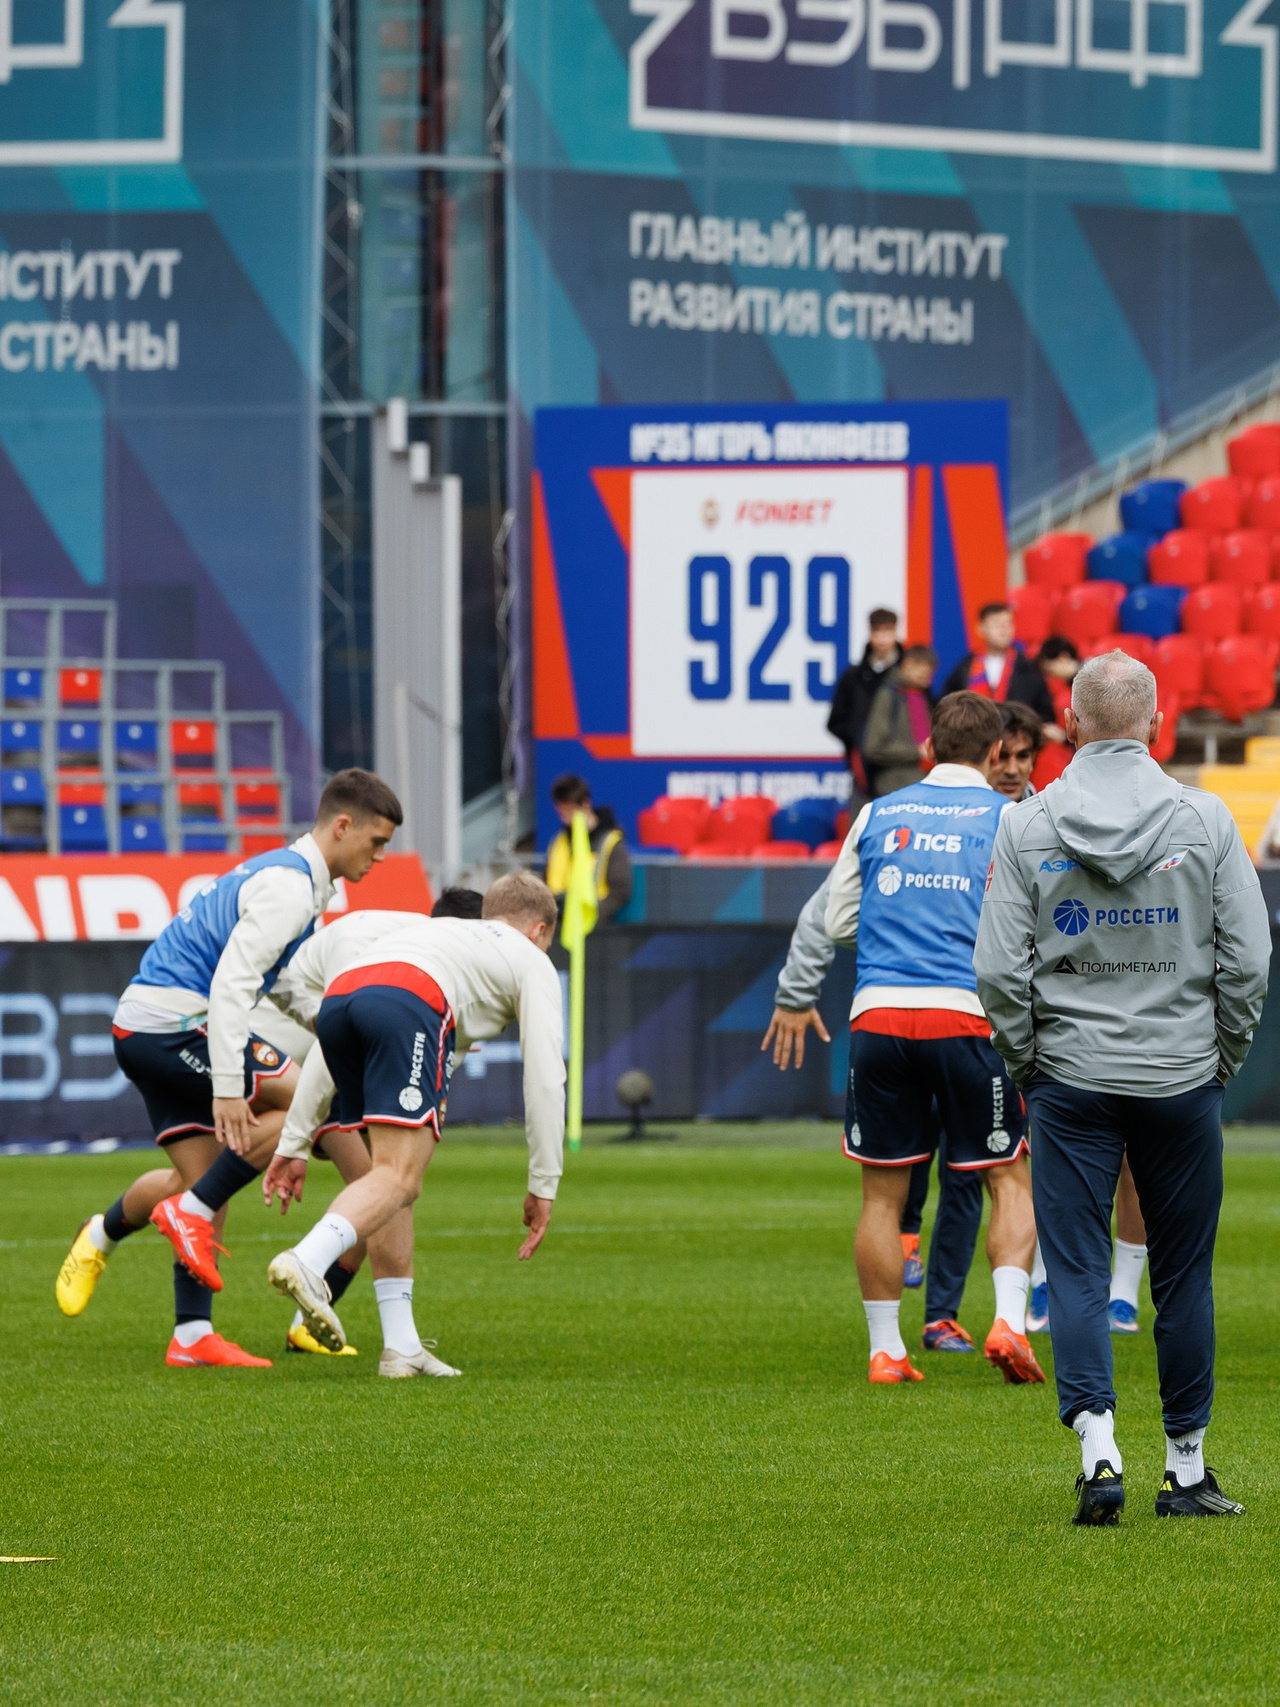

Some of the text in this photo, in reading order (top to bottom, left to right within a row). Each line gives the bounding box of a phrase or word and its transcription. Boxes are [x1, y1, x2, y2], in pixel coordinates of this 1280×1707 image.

[630, 209, 1009, 280] ГЛАВНЫЙ ИНСТИТУТ
[629, 277, 975, 345] РАЗВИТИЯ СТРАНЫ
[0, 320, 180, 373] СТРАНЫ
[734, 499, 835, 526] FONBET
[687, 555, 850, 702] 929
[876, 803, 962, 817] АЭРОФЛОТ
[913, 833, 962, 853] ПСБ
[904, 872, 971, 893] РОССЕТИ
[1095, 906, 1179, 926] РОССЕТИ
[1081, 960, 1177, 975] ПОЛИМЕТАЛЛ
[409, 1031, 426, 1087] РОССЕТИ
[991, 1075, 1004, 1129] РОССЕТИ
